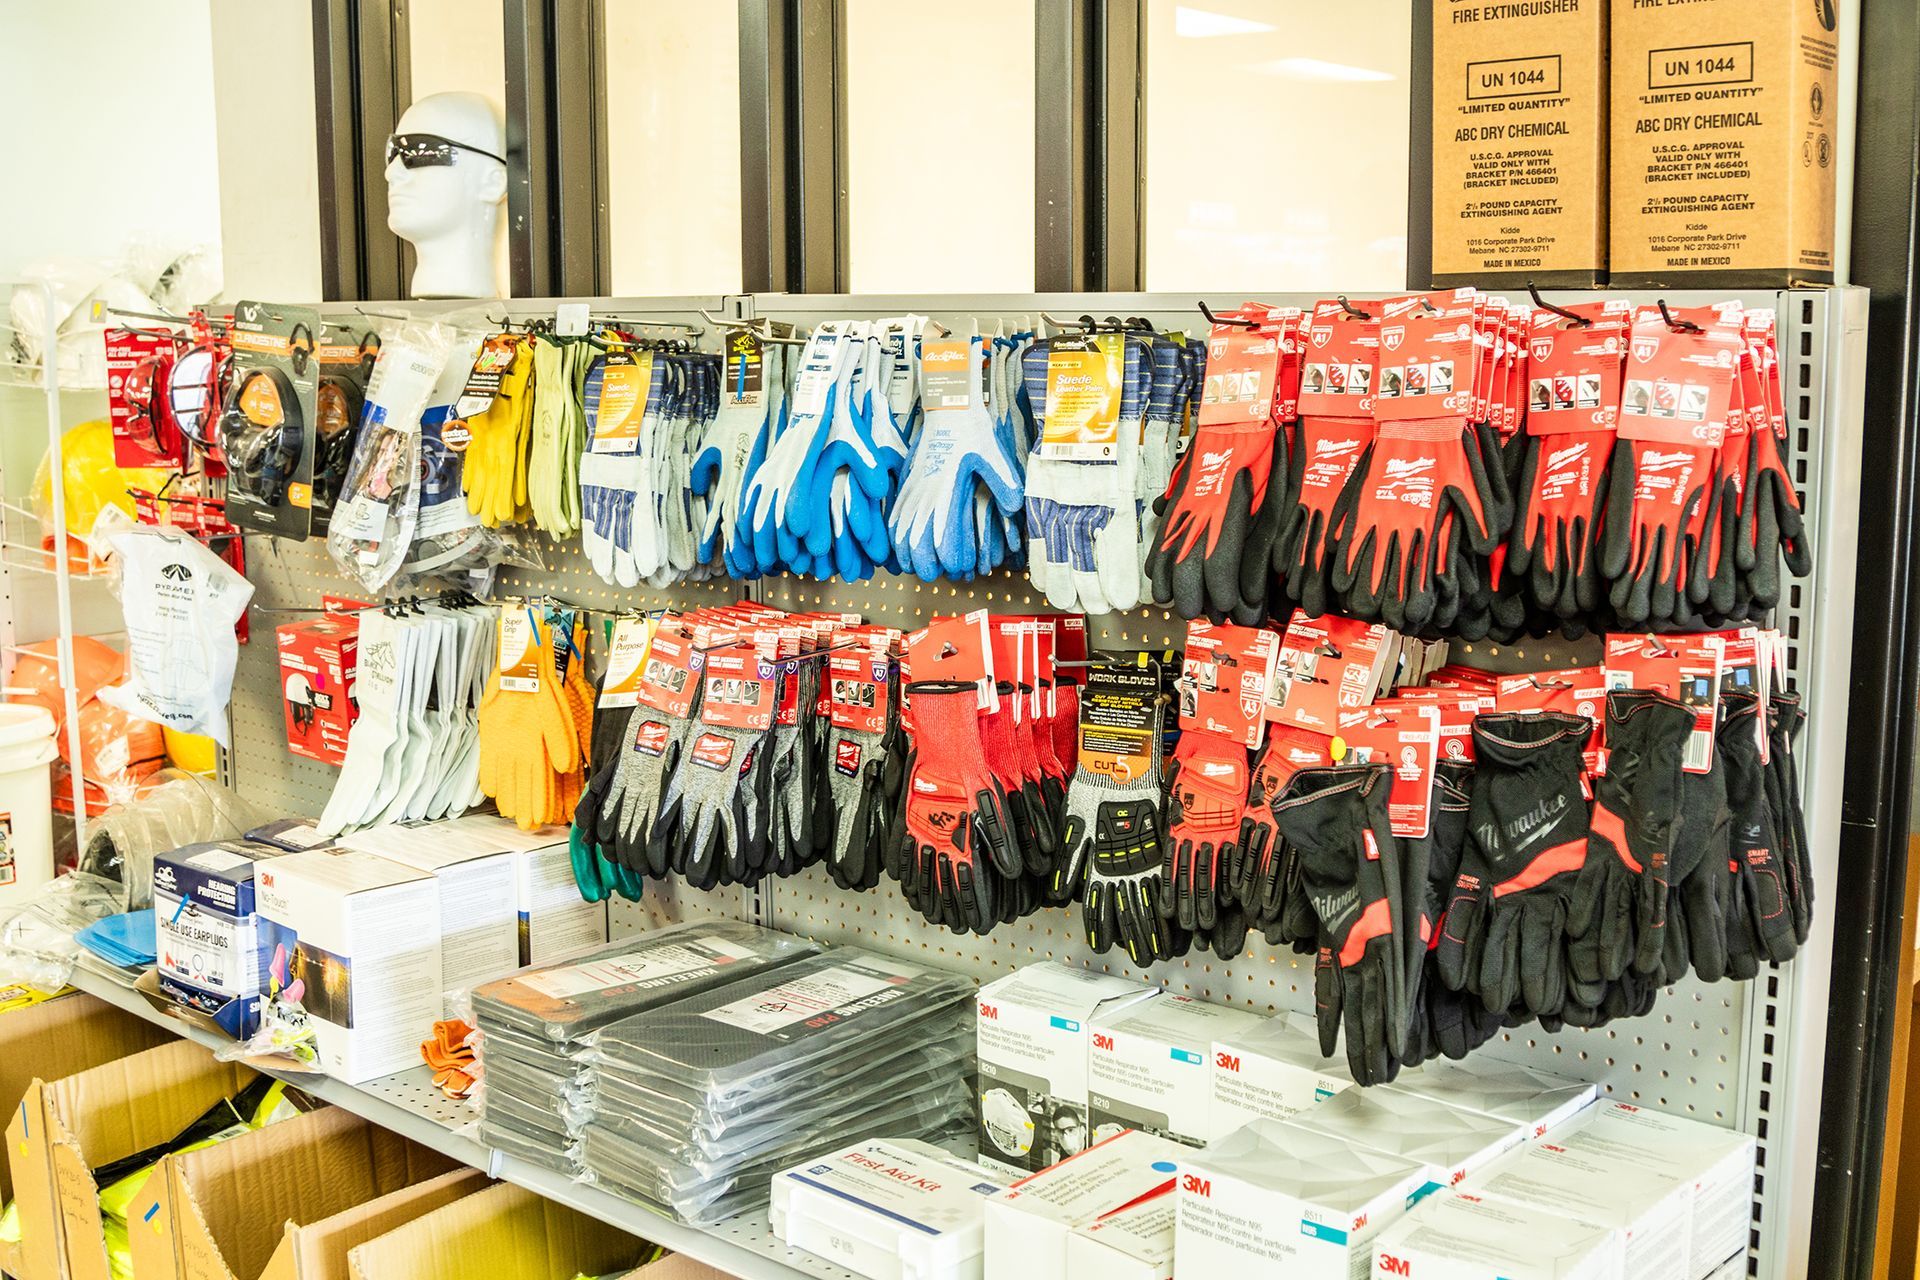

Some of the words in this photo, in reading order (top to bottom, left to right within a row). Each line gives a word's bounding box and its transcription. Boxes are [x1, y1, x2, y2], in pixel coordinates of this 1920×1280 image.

[1453, 8, 1479, 24] FIRE
[1484, 0, 1579, 21] EXTINGUISHER
[1666, 61, 1689, 76] UN
[1696, 57, 1735, 74] 1044
[1482, 73, 1503, 87] UN
[1510, 70, 1544, 85] 1044
[1636, 118, 1660, 133] ABC
[1664, 116, 1691, 132] DRY
[1694, 112, 1762, 129] CHEMICAL
[1455, 129, 1477, 142] ABC
[1481, 126, 1505, 140] DRY
[1508, 121, 1569, 138] CHEMICAL
[1652, 145, 1689, 154] U.S.C.G.
[1693, 141, 1744, 151] APPROVAL
[1470, 153, 1504, 161] U.S.C.G.
[1507, 149, 1553, 158] APPROVAL
[1656, 154, 1683, 163] VALID
[1686, 153, 1711, 161] ONLY
[1715, 151, 1740, 159] WITH
[1501, 160, 1523, 168] ONLY
[1648, 163, 1691, 173] BRACKET
[1695, 162, 1711, 170] P/N
[1714, 160, 1748, 169] 466401
[1466, 171, 1506, 179] BRACKET
[1645, 173, 1692, 184] (BRACKET
[1697, 170, 1750, 180] INCLUDED)
[1464, 179, 1507, 189] (BRACKET
[1510, 176, 1559, 186] INCLUDED)
[1480, 201, 1511, 209] POUND
[1513, 199, 1557, 208] CAPACITY
[1664, 196, 1697, 204] POUND
[1700, 194, 1749, 203] CAPACITY
[1461, 209, 1529, 218] EXTINGUISHING
[1532, 207, 1563, 215] AGENT
[1642, 204, 1718, 215] EXTINGUISHING
[1721, 202, 1755, 211] AGENT
[1484, 238, 1518, 247] Corporate
[1667, 234, 1704, 244] Corporate
[1707, 233, 1724, 242] Park
[1726, 233, 1747, 241] Drive
[1514, 259, 1541, 267] MEXICO
[1667, 258, 1688, 266] MADE
[1691, 258, 1698, 266] IN
[1701, 257, 1730, 266] MEXICO
[1315, 333, 1327, 342] A1
[1386, 335, 1399, 345] A1
[1536, 346, 1548, 356] A1
[1637, 347, 1651, 356] A1
[1056, 375, 1092, 385] Suede
[608, 384, 630, 392] Suede
[1056, 385, 1083, 393] Leather
[504, 617, 522, 628] Super
[503, 625, 517, 634] Grip
[618, 634, 628, 642] All
[616, 642, 644, 651] Purpose
[1089, 673, 1117, 683] WORK
[1118, 675, 1156, 686] GLOVES
[1244, 700, 1257, 712] A3
[1343, 694, 1358, 707] A3
[1094, 760, 1117, 772] CUT
[1112, 755, 1131, 782] 5
[261, 873, 274, 888] 3M
[1459, 874, 1480, 883] SMART
[208, 880, 236, 895] HEARING
[198, 886, 236, 905] PROTECTION
[181, 924, 192, 937] USE
[194, 928, 228, 948] EARPLUGS
[638, 968, 719, 988] KNEELING
[834, 989, 904, 1017] KNEELING
[980, 1003, 997, 1019] 3M
[804, 1013, 840, 1028] PAD
[1093, 1033, 1113, 1051] 3M
[1216, 1052, 1240, 1072] 3M
[981, 1062, 996, 1076] 8210
[1318, 1080, 1334, 1091] 8511
[1093, 1096, 1110, 1109] 8210
[1533, 1124, 1547, 1140] 3M
[844, 1153, 887, 1169] First
[883, 1167, 916, 1183] Aid
[912, 1176, 941, 1193] Kit
[1450, 1169, 1466, 1186] 3M
[1183, 1174, 1211, 1197] 3M
[1182, 1198, 1214, 1215] Particulate
[1215, 1208, 1246, 1226] Respirator
[1249, 1220, 1262, 1232] N95
[1304, 1209, 1323, 1223] 8511
[1352, 1214, 1368, 1232] 3M
[1182, 1208, 1215, 1227] Respirateur
[1217, 1222, 1230, 1233] N95
[1232, 1228, 1252, 1240] contre
[1253, 1234, 1263, 1244] les
[1264, 1237, 1296, 1255] particules
[1302, 1224, 1317, 1236] N95
[1182, 1219, 1212, 1238] Respirador
[1215, 1232, 1234, 1246] contra
[1268, 1250, 1282, 1262] N95
[1379, 1253, 1410, 1277] 3M
